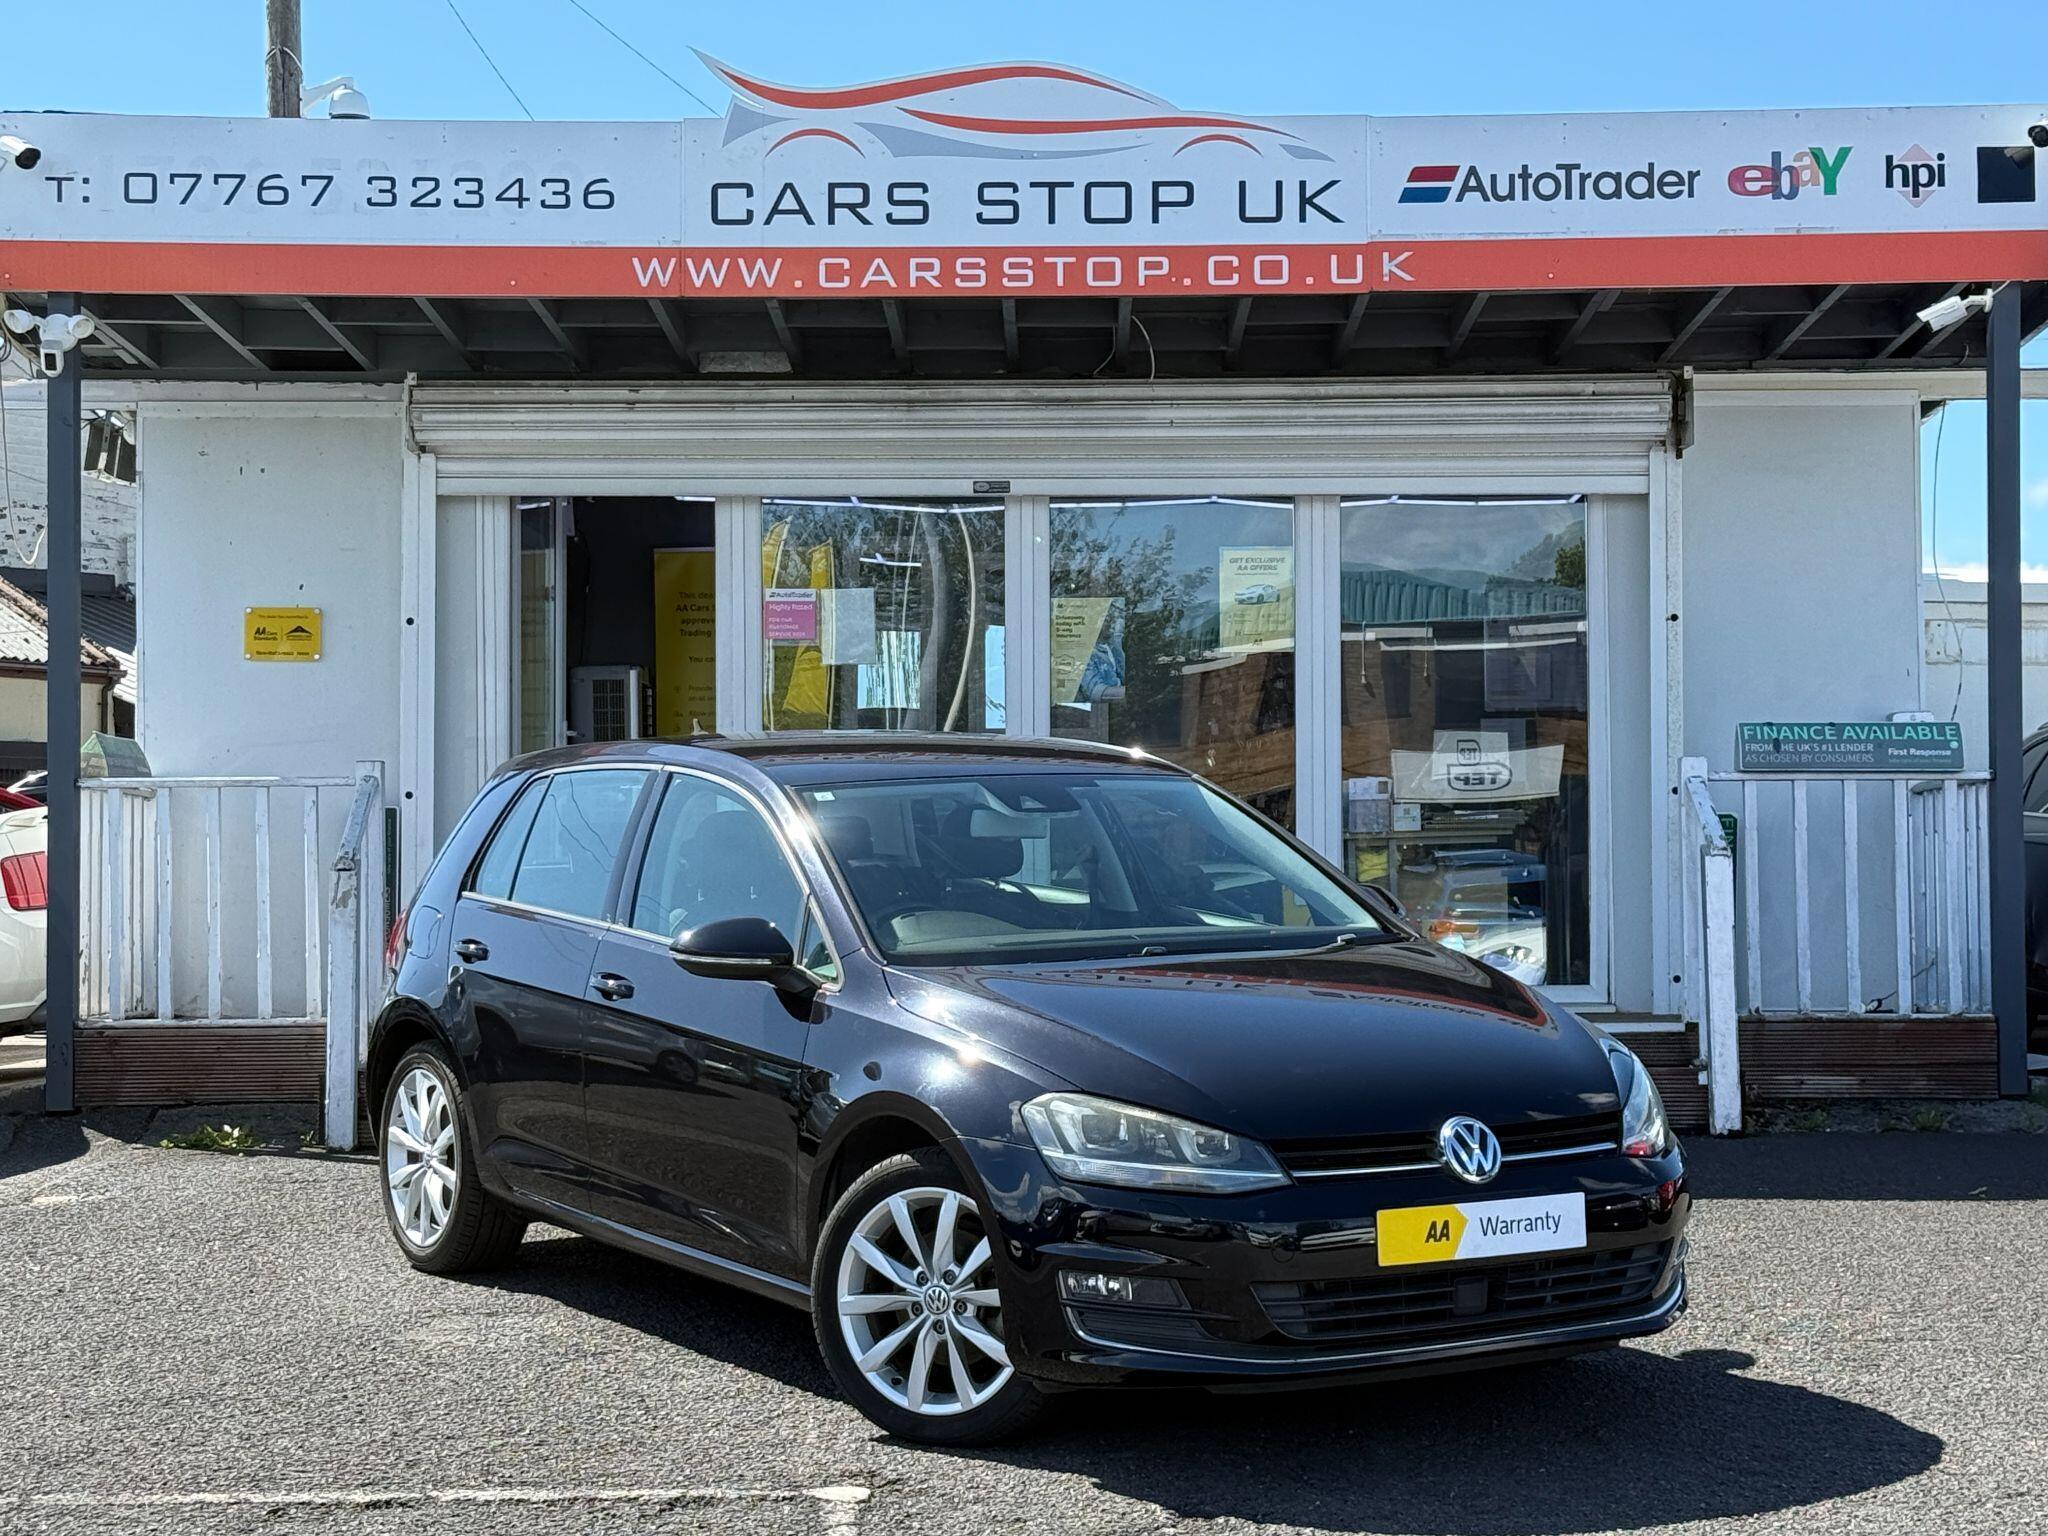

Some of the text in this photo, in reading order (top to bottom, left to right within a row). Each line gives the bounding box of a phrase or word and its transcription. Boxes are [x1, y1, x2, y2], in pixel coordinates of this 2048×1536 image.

[1455, 161, 1701, 203] AutoTrader
[1885, 152, 1946, 199] hpi
[45, 172, 616, 210] T: 07767 323436
[710, 179, 1346, 226] CARS STOP UK
[676, 603, 689, 612] AA
[690, 603, 710, 612] Cars
[680, 629, 712, 639] Trading
[1743, 725, 1959, 741] FINANCE AVAILABLE
[1744, 743, 1773, 752] FROM
[1797, 743, 1820, 752] UK'S
[1835, 743, 1874, 752] LENDER
[1814, 753, 1874, 763] CONSUMERS
[1425, 1211, 1561, 1244] AA Warranty
